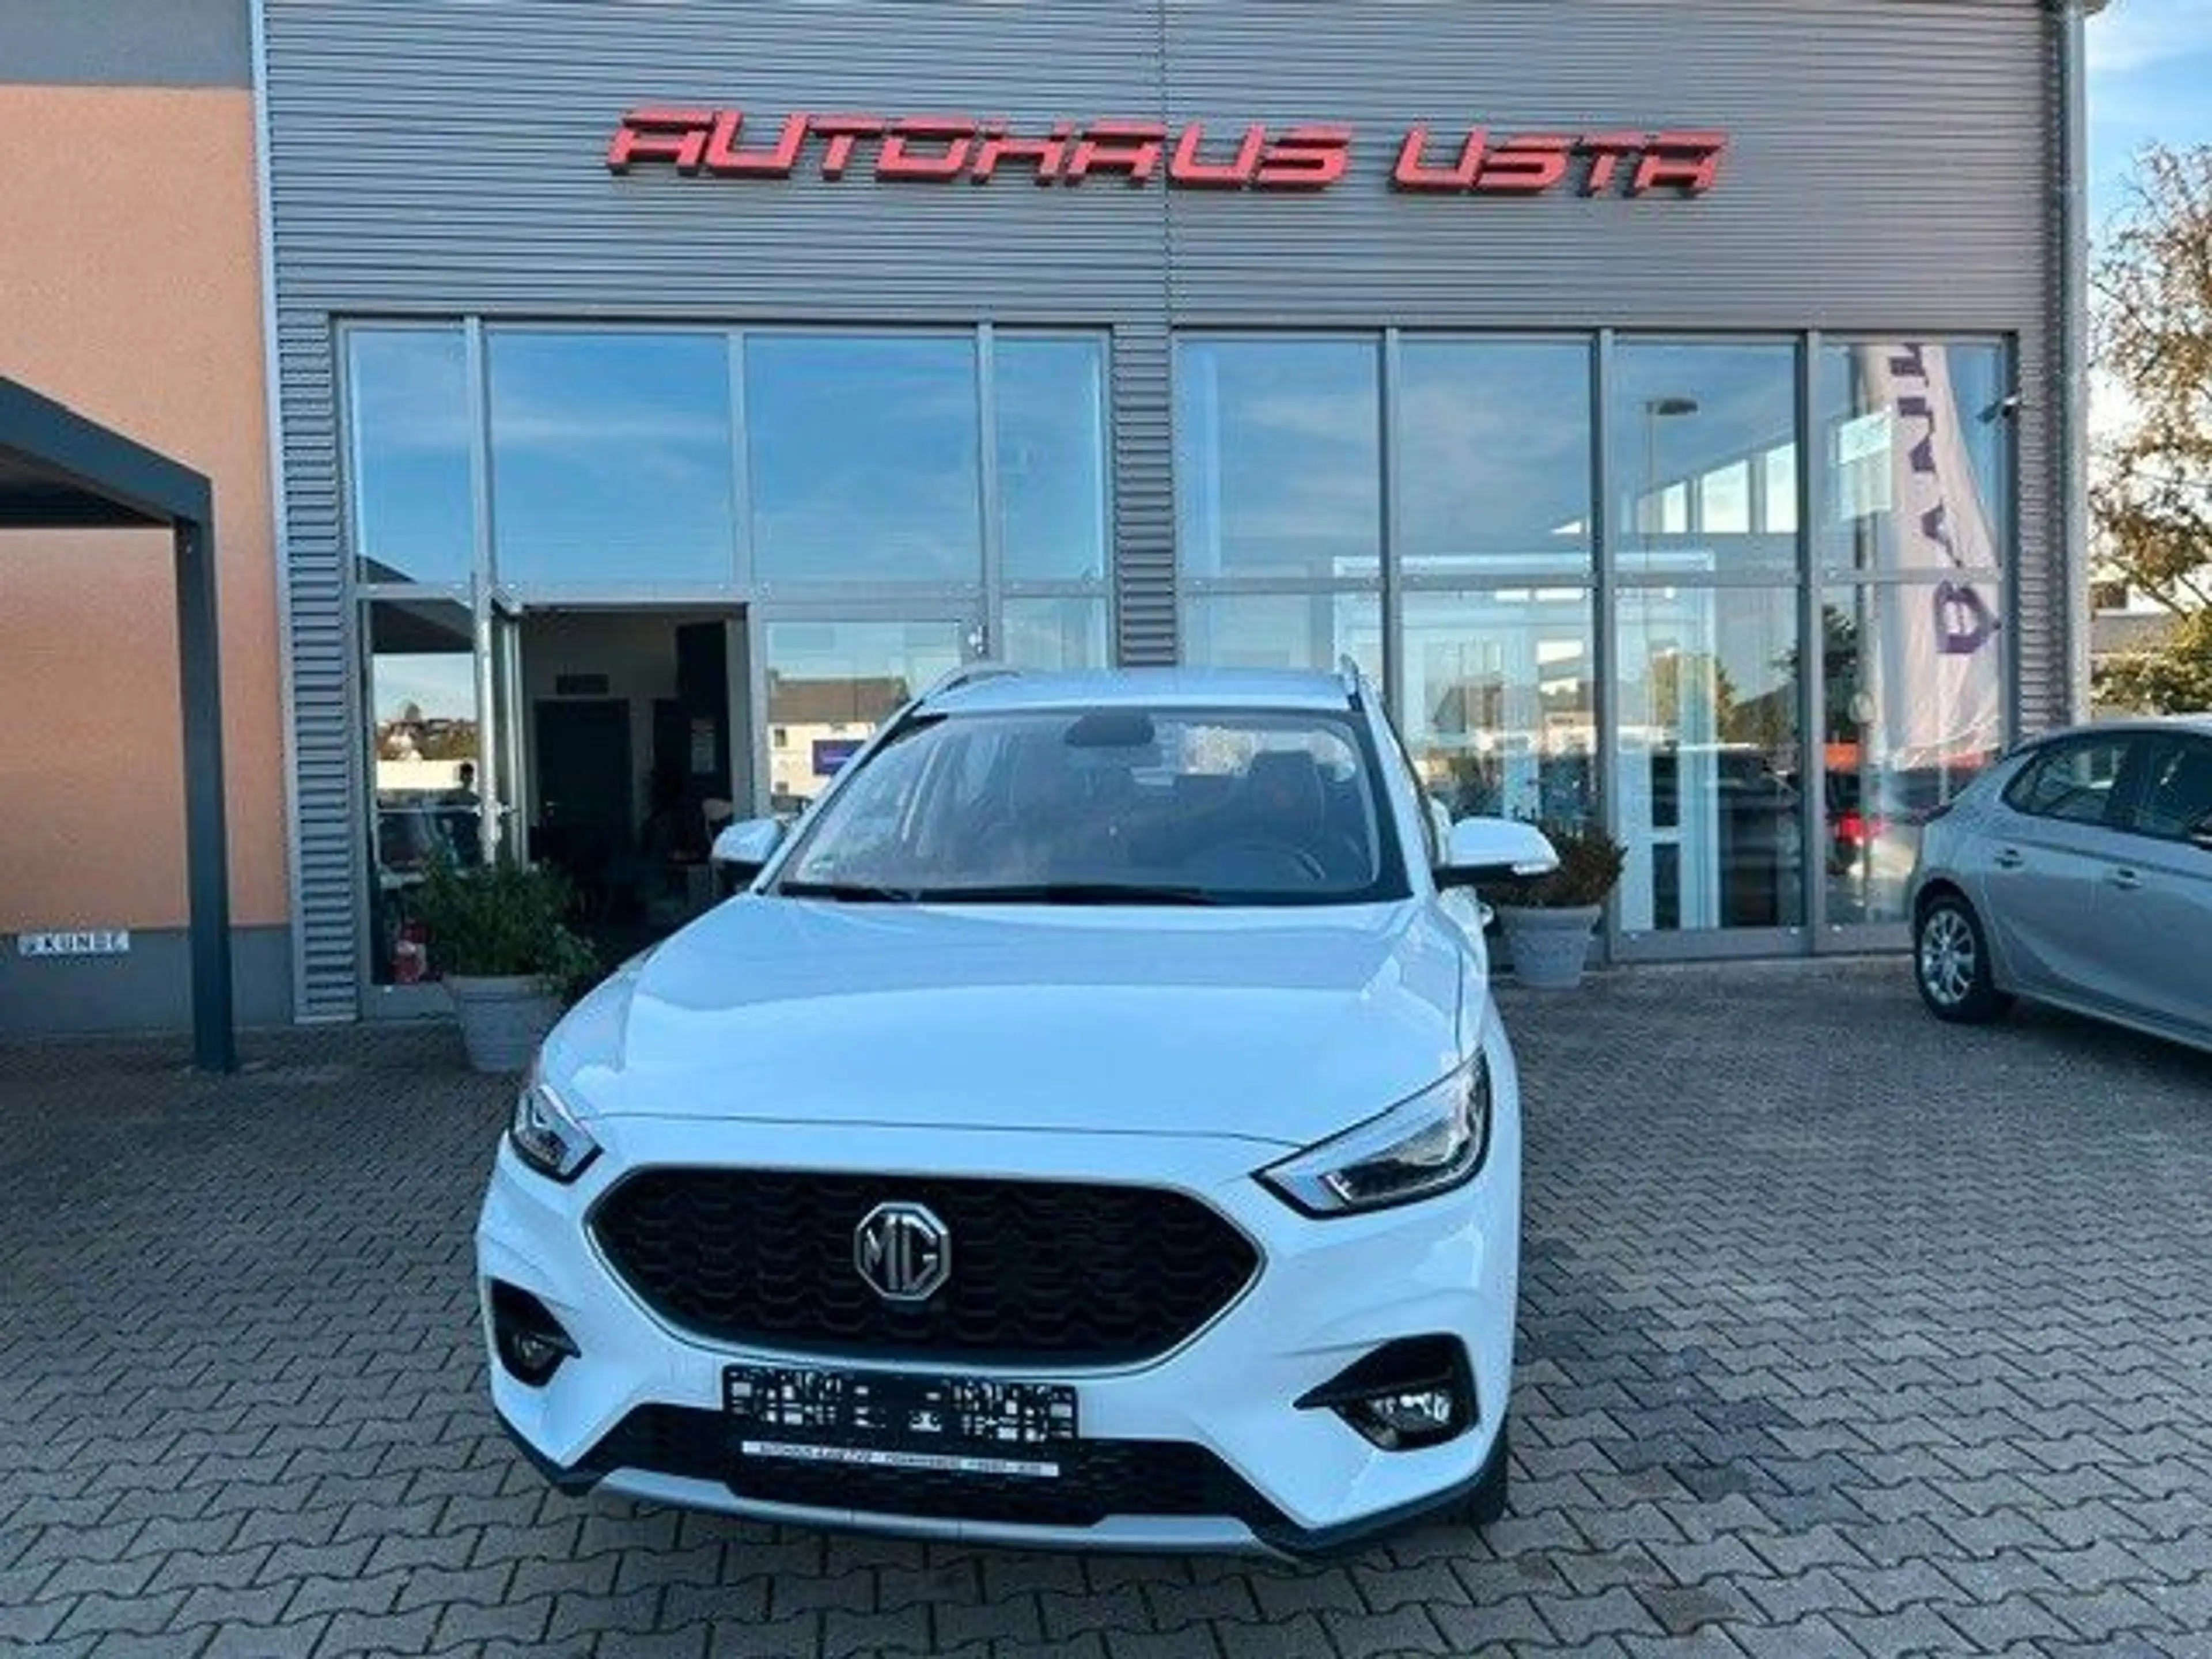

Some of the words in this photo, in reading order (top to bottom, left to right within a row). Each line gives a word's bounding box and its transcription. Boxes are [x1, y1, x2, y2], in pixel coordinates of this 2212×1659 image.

[607, 108, 1354, 189] AUTOHAUS
[1392, 128, 1728, 195] USTA
[864, 1213, 938, 1292] MG
